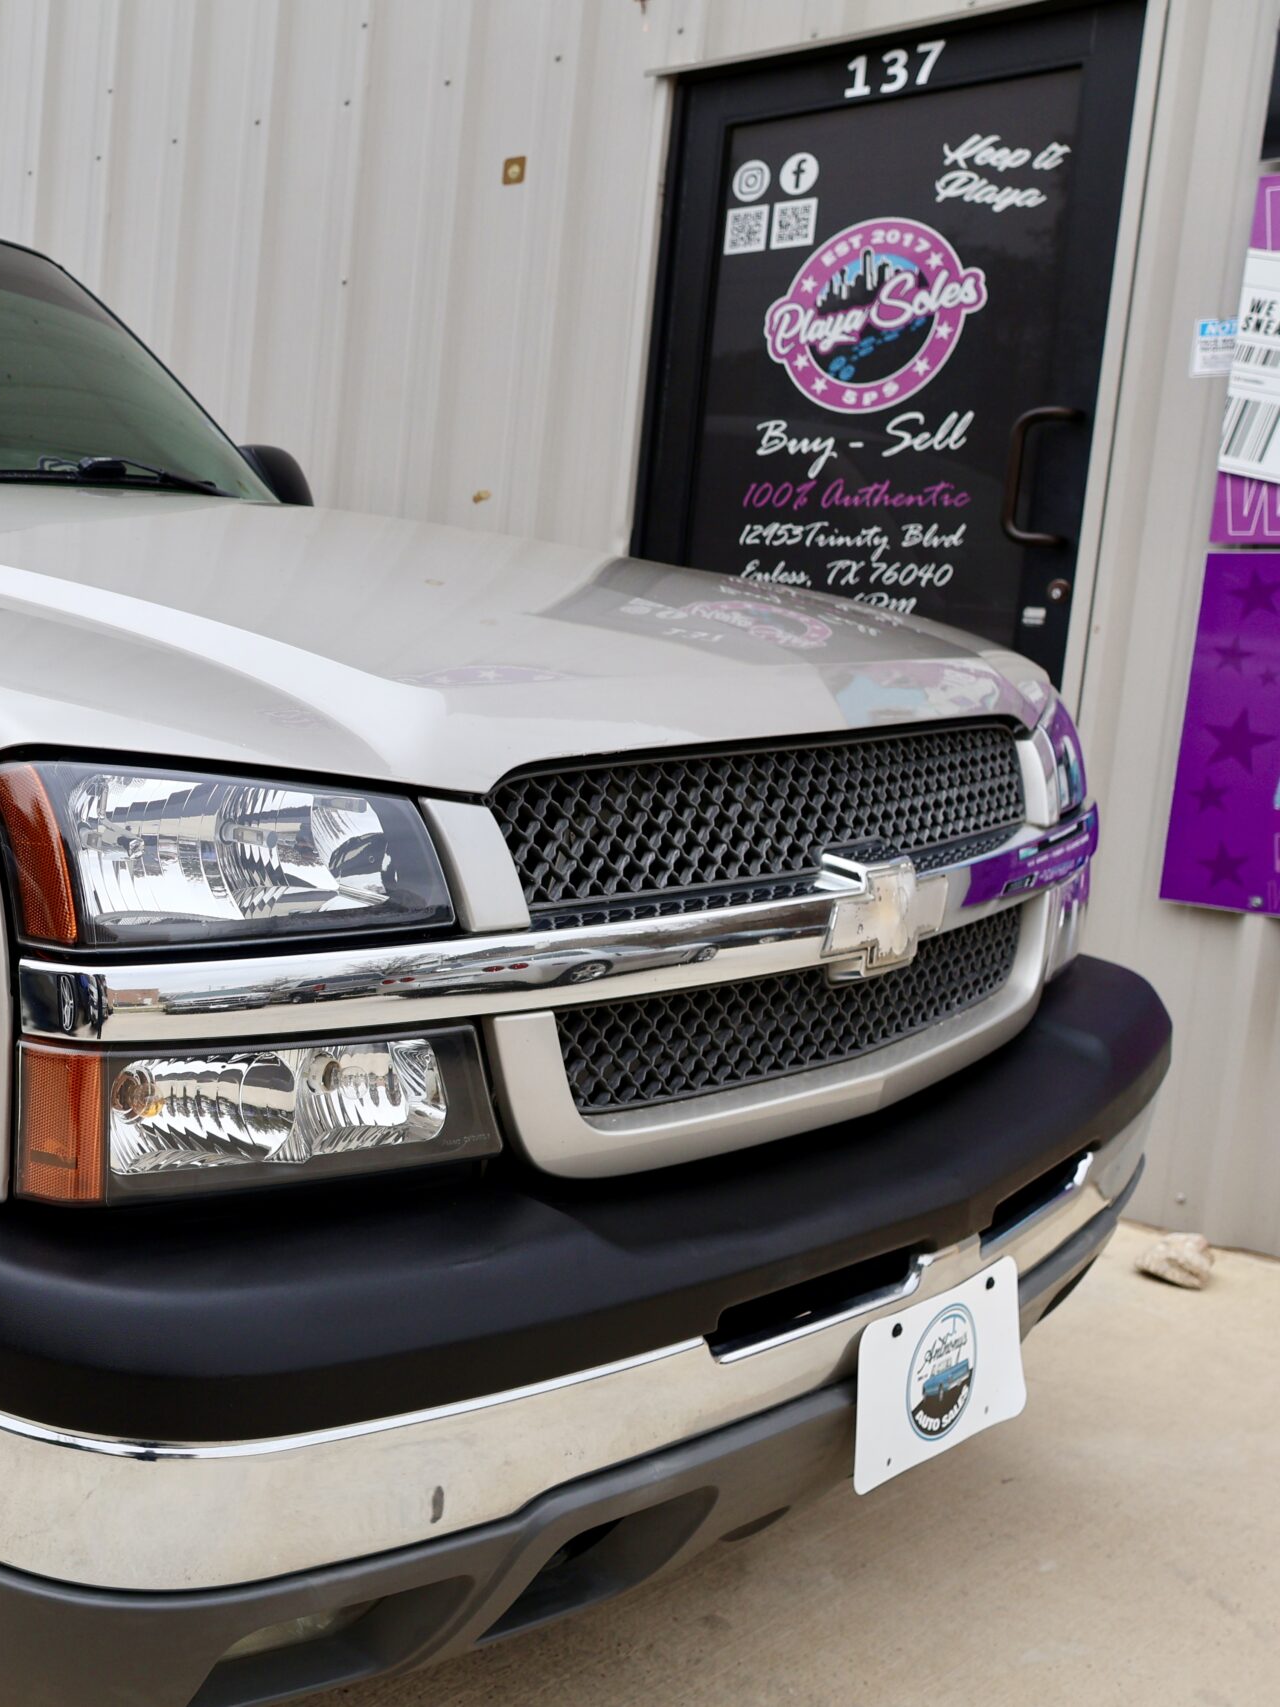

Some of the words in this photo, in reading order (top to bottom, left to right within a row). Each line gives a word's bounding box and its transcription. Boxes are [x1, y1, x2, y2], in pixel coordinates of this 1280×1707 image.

[844, 39, 947, 98] 137
[943, 133, 1032, 172] Keep
[1032, 141, 1072, 171] it
[935, 169, 1048, 213] Playa
[821, 233, 864, 267] EST
[870, 228, 932, 253] 2017
[772, 302, 870, 353] Playa
[871, 269, 978, 328] Soles
[756, 419, 838, 479] Buy
[881, 410, 974, 457] Sell
[742, 479, 817, 511] 100%
[820, 477, 972, 509] Authentic
[900, 522, 968, 549] Blvd
[826, 559, 866, 585] TX
[869, 562, 955, 588] 76040
[914, 1410, 941, 1432] AUTO
[941, 1383, 970, 1428] SALES
